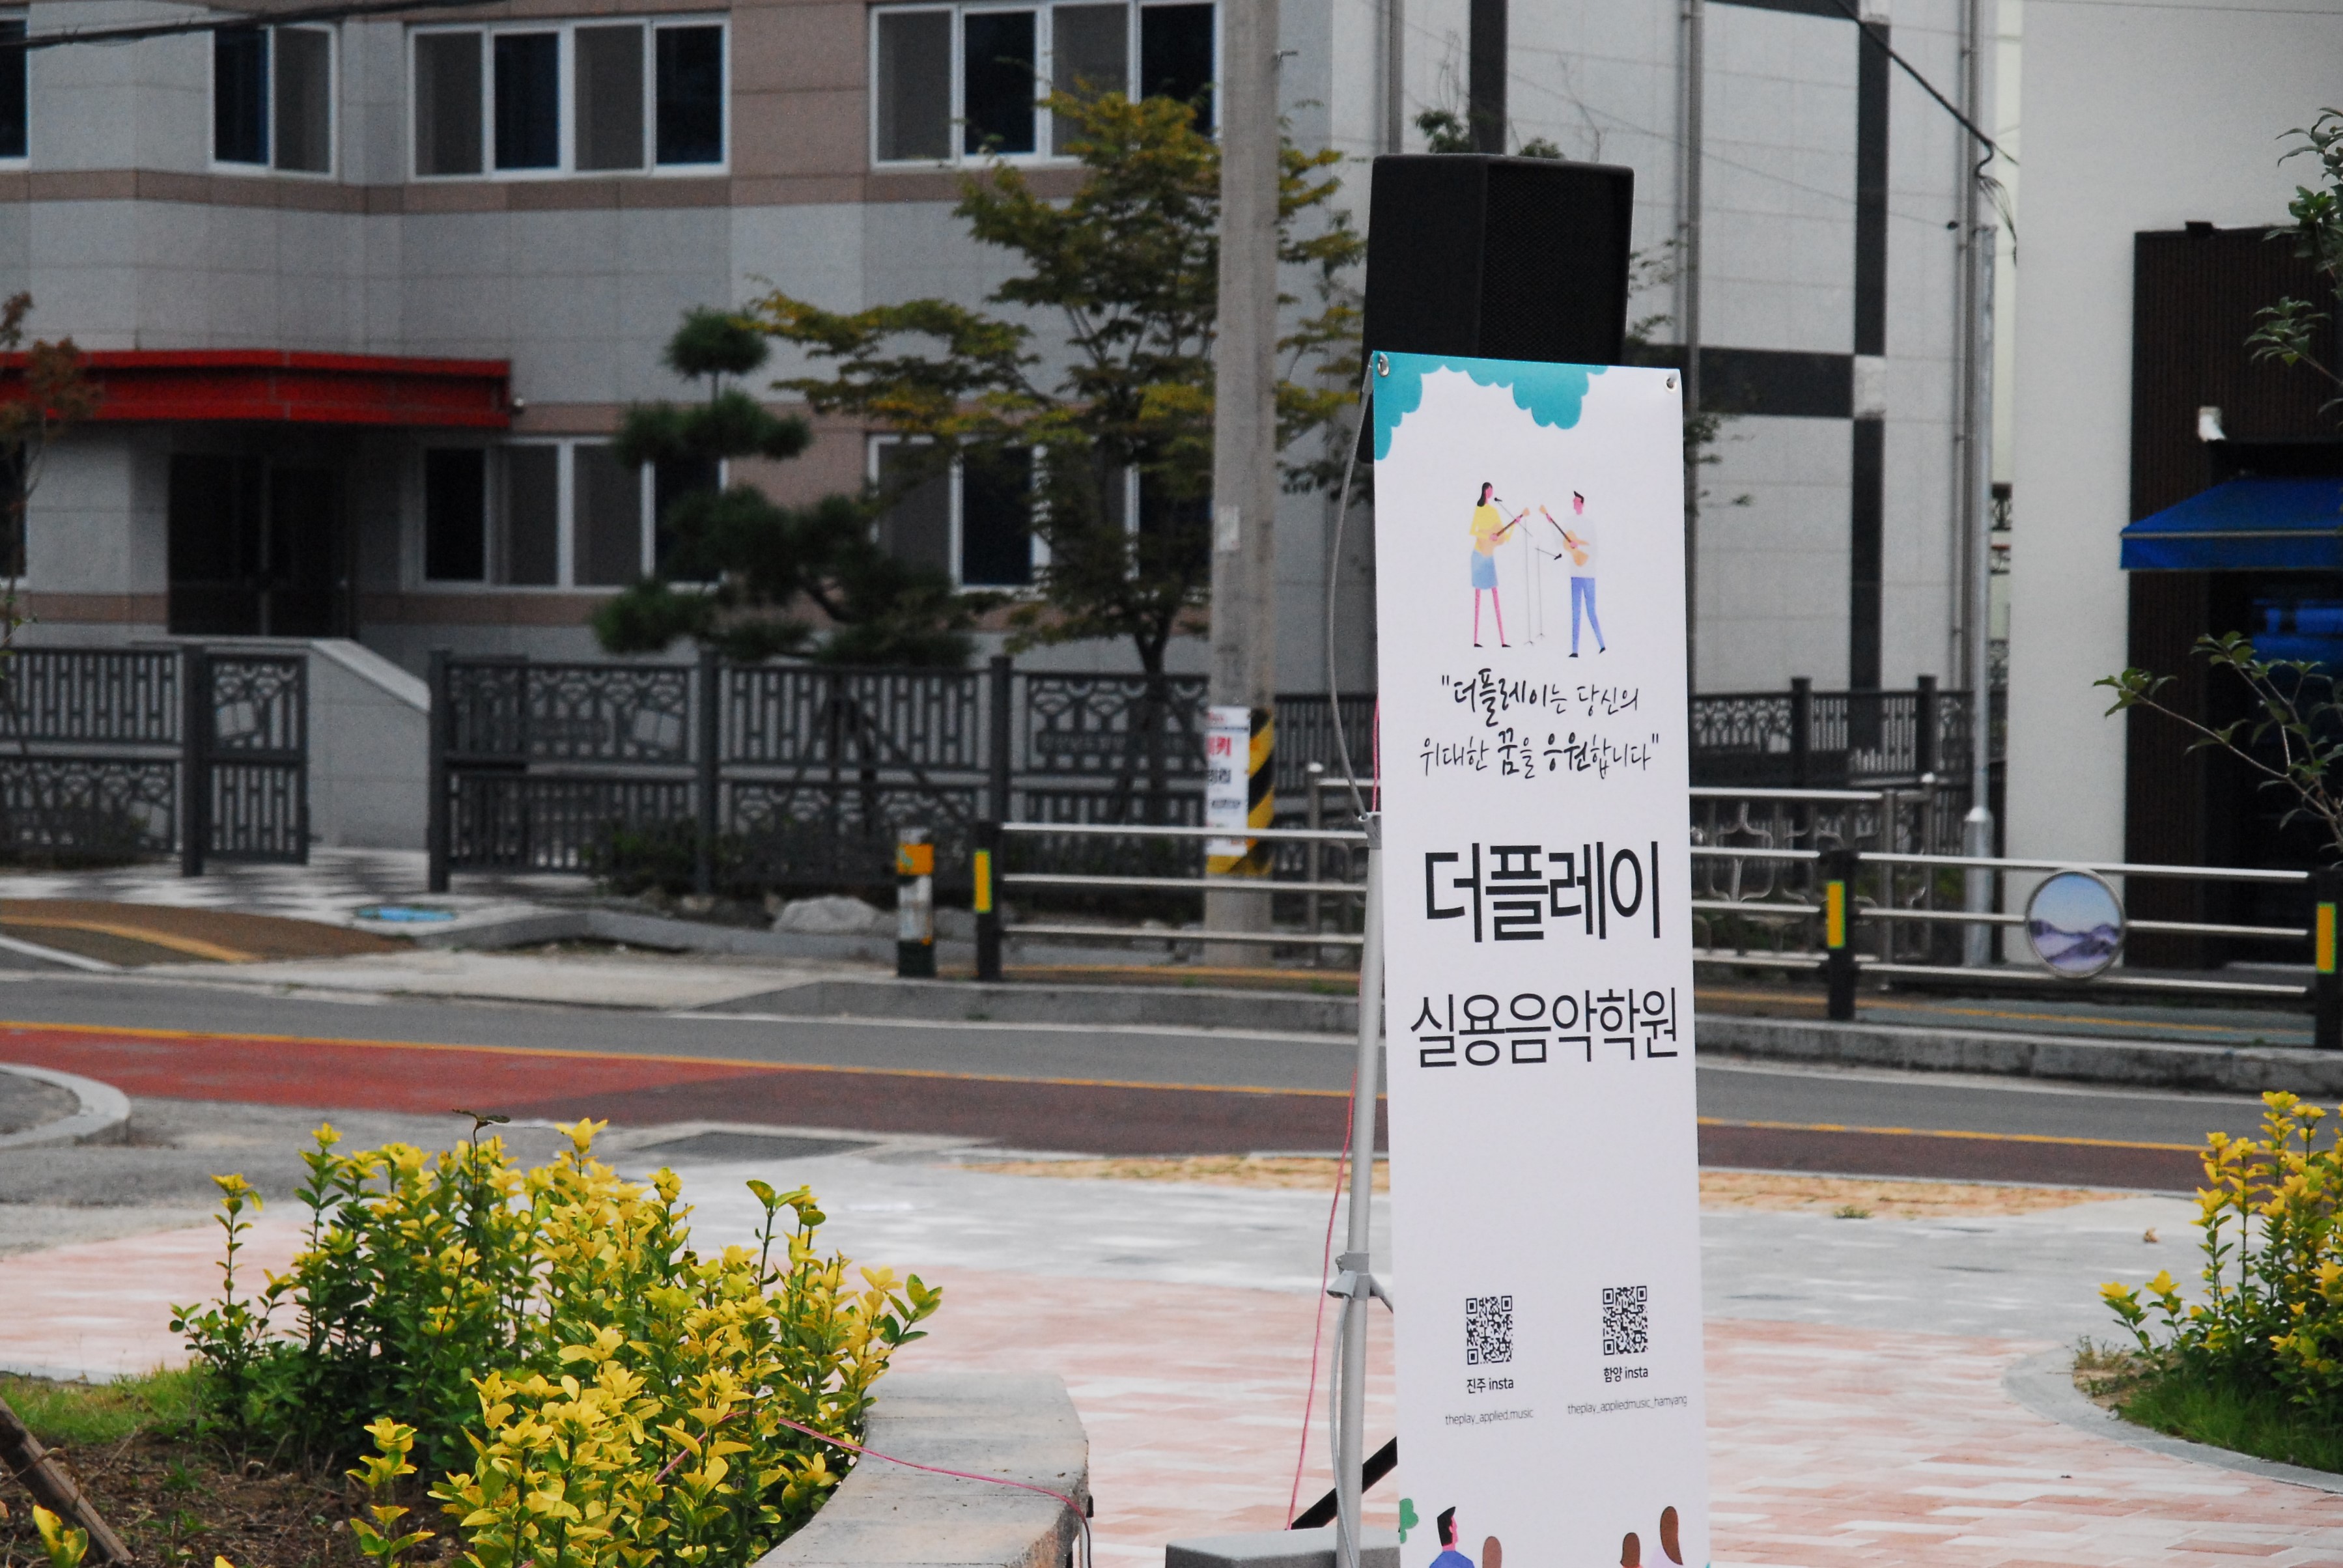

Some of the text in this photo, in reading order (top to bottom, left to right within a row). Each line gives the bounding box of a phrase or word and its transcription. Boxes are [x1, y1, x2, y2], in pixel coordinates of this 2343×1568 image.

[1576, 683, 1640, 717] 당신의
[1420, 736, 1490, 777] 위대한
[1497, 727, 1536, 779] 꿈을
[1425, 841, 1661, 943] 더플레이
[1410, 987, 1678, 1068] 실용음악학원
[1466, 1377, 1514, 1394] 진주 insta
[1603, 1366, 1649, 1383] 함양 insta
